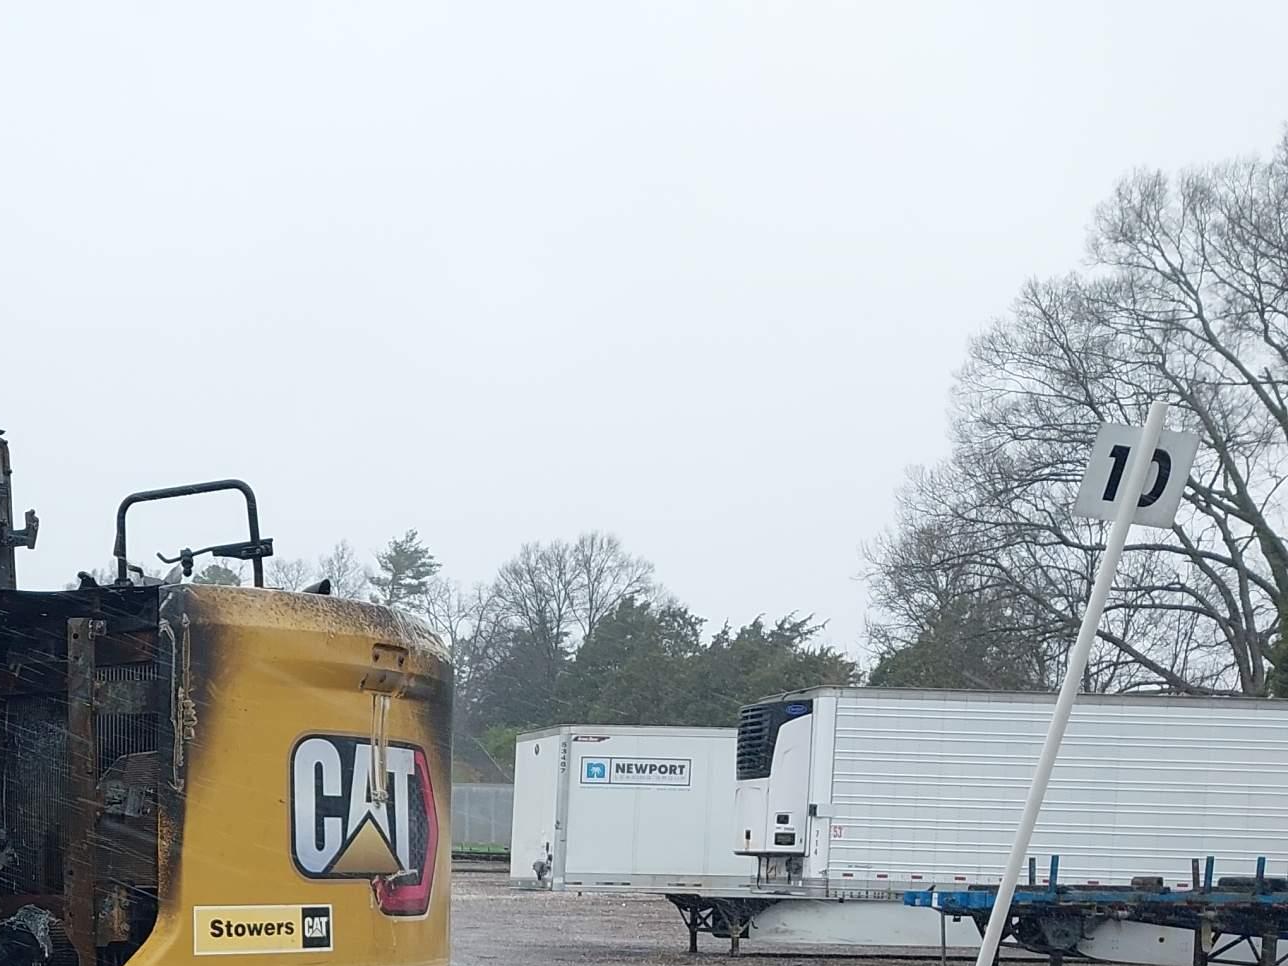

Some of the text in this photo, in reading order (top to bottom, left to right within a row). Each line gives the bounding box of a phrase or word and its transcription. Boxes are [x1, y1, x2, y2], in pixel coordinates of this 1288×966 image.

[615, 763, 686, 776] NEWPORT
[293, 737, 415, 875] CAT
[210, 919, 295, 938] Stowers
[304, 916, 329, 938] CAT
